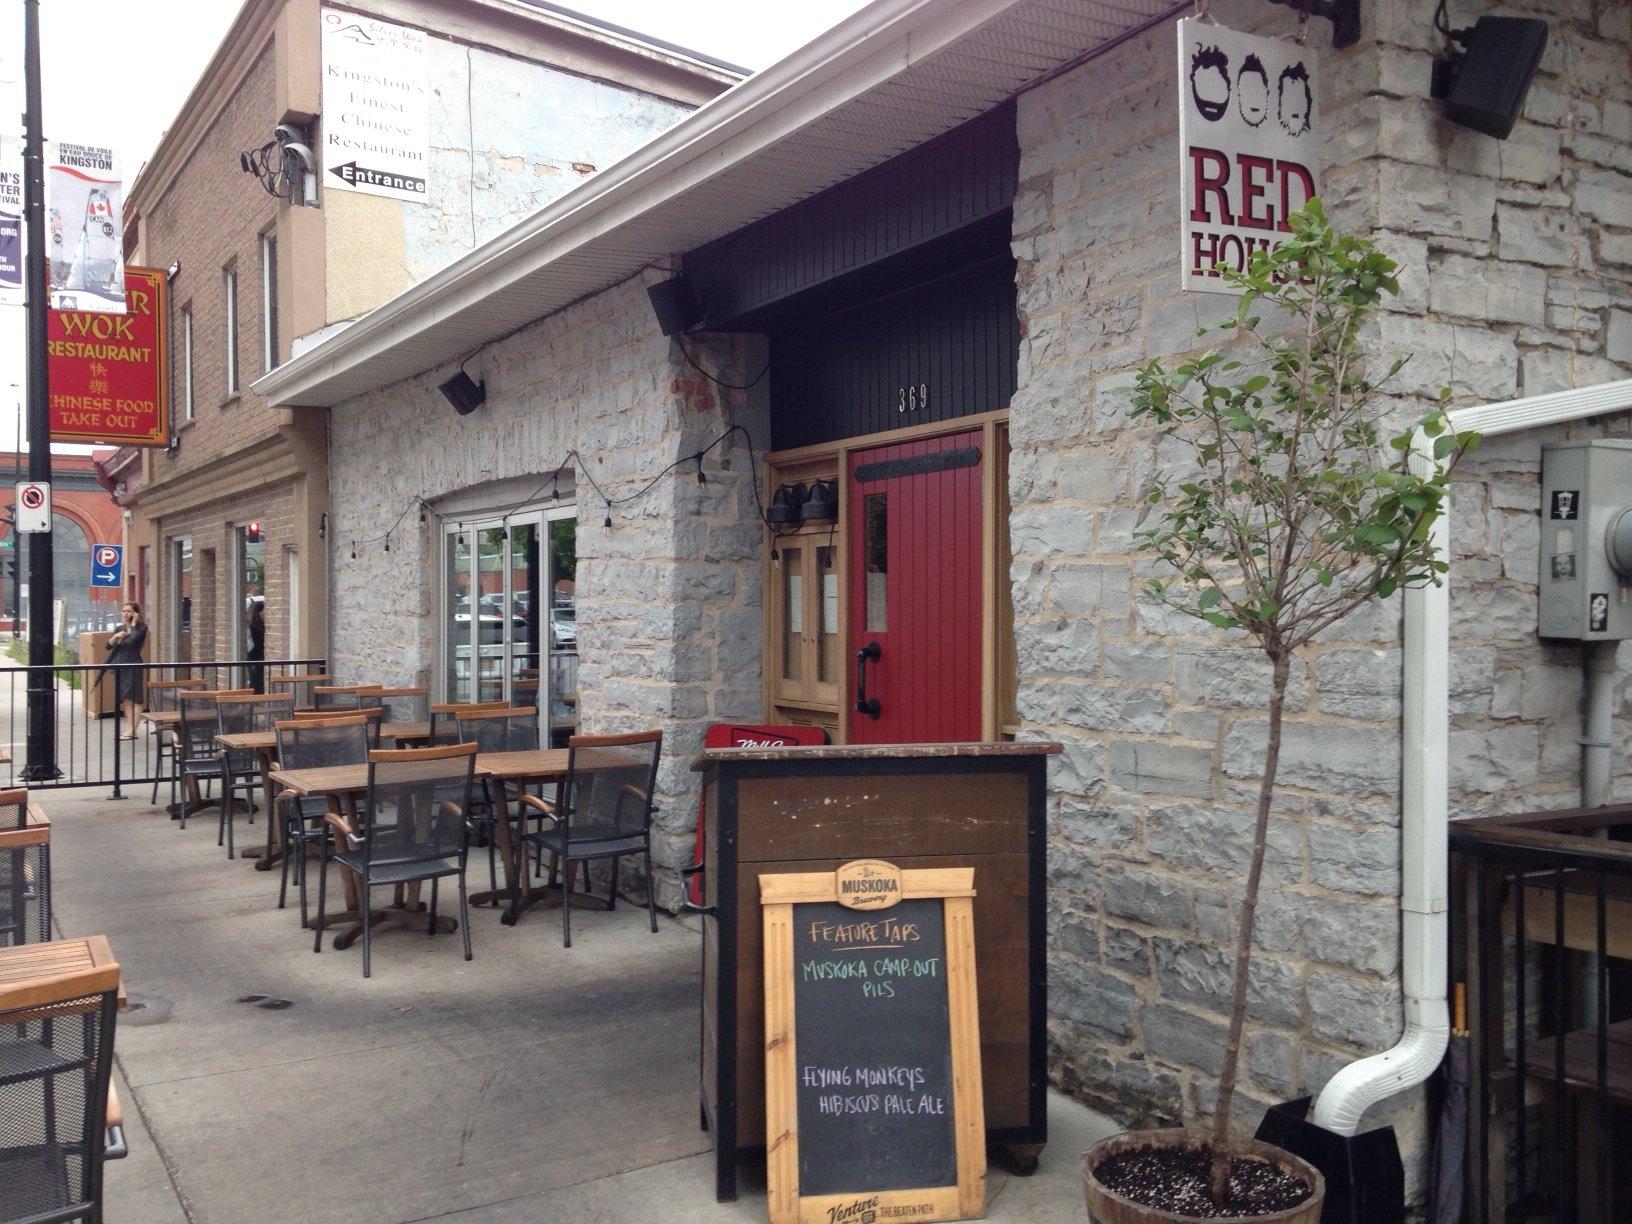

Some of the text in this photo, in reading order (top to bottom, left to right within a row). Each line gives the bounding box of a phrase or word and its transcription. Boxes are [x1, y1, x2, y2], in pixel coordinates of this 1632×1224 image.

[328, 64, 424, 94] Kingston's
[349, 91, 403, 113] Finest
[341, 113, 412, 136] Chinese
[60, 143, 85, 151] FESTIVAL
[328, 133, 423, 160] Restaurant
[60, 154, 112, 170] KINGSTON
[341, 165, 425, 193] Entrance
[1189, 146, 1316, 234] RED
[1191, 231, 1316, 285] HOU
[59, 313, 135, 341] WOK
[48, 341, 151, 363] RESTAURANT
[116, 400, 154, 413] FOOD
[899, 384, 926, 412] 369
[60, 412, 138, 428] TAKE OUT
[101, 549, 116, 565] P
[842, 879, 898, 894] MUSKOKA
[851, 895, 887, 906] Brewery
[808, 918, 920, 943] FEATURE TAPS
[803, 959, 867, 982] MUSKOKA
[863, 981, 895, 998] PILS
[803, 1066, 925, 1091] FLYING MONKEYS
[819, 1093, 945, 1116] HIBISCUS PALE ALE
[826, 1195, 880, 1224] Venture
